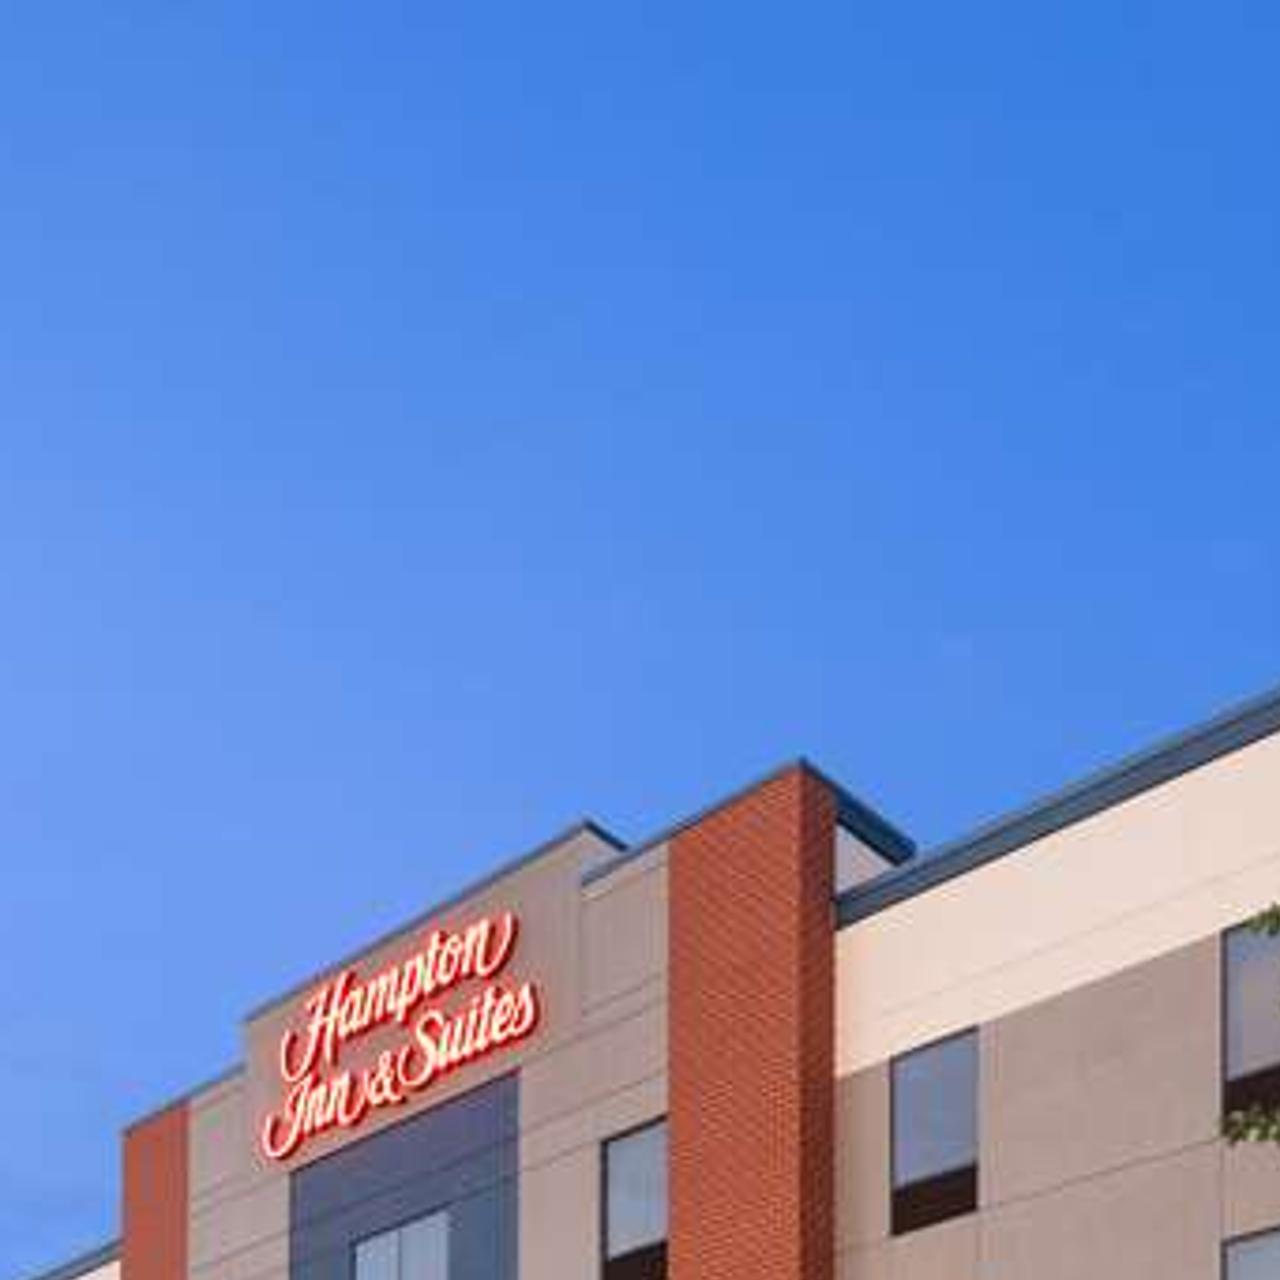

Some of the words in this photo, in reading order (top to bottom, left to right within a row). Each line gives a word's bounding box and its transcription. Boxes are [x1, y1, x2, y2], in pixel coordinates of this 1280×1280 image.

[262, 1068, 368, 1160] Inn
[368, 1049, 406, 1106] &
[397, 983, 540, 1089] Suites
[280, 911, 518, 1083] Hampton
